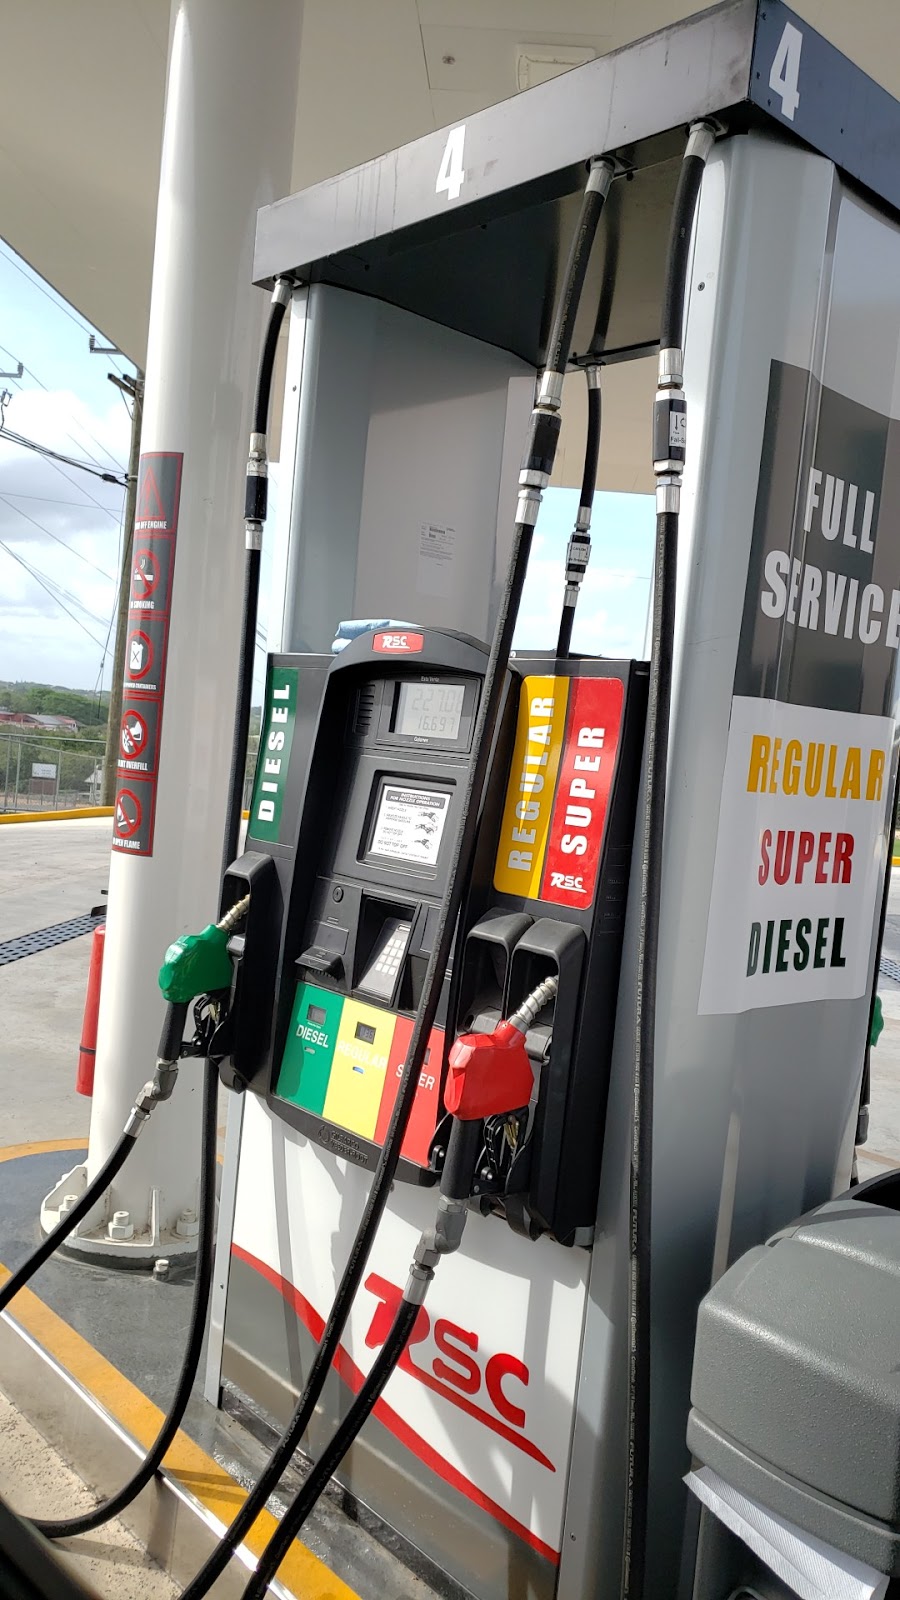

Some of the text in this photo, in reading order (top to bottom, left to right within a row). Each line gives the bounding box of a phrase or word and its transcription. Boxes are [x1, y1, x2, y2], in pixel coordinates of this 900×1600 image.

[768, 21, 803, 122] 4
[435, 124, 466, 201] 4
[147, 520, 168, 530] ENGINE
[803, 467, 875, 555] FULL
[134, 600, 155, 610] SMOKING
[760, 550, 900, 649] SERVICE
[382, 635, 411, 650] RSC
[126, 760, 148, 771] OVERFILL
[257, 684, 290, 822] DIESEL
[746, 734, 886, 801] REGULAR
[507, 697, 554, 872] REGULAR
[561, 727, 605, 856] SUPER
[124, 839, 141, 850] FLAME
[758, 829, 855, 886] SUPER
[550, 872, 586, 892] RSC
[746, 917, 846, 978] DIESEL
[295, 1024, 329, 1049] DIESEL
[337, 1039, 389, 1070] REGULAR
[395, 1063, 436, 1091] SER
[364, 1272, 530, 1430] RSC
